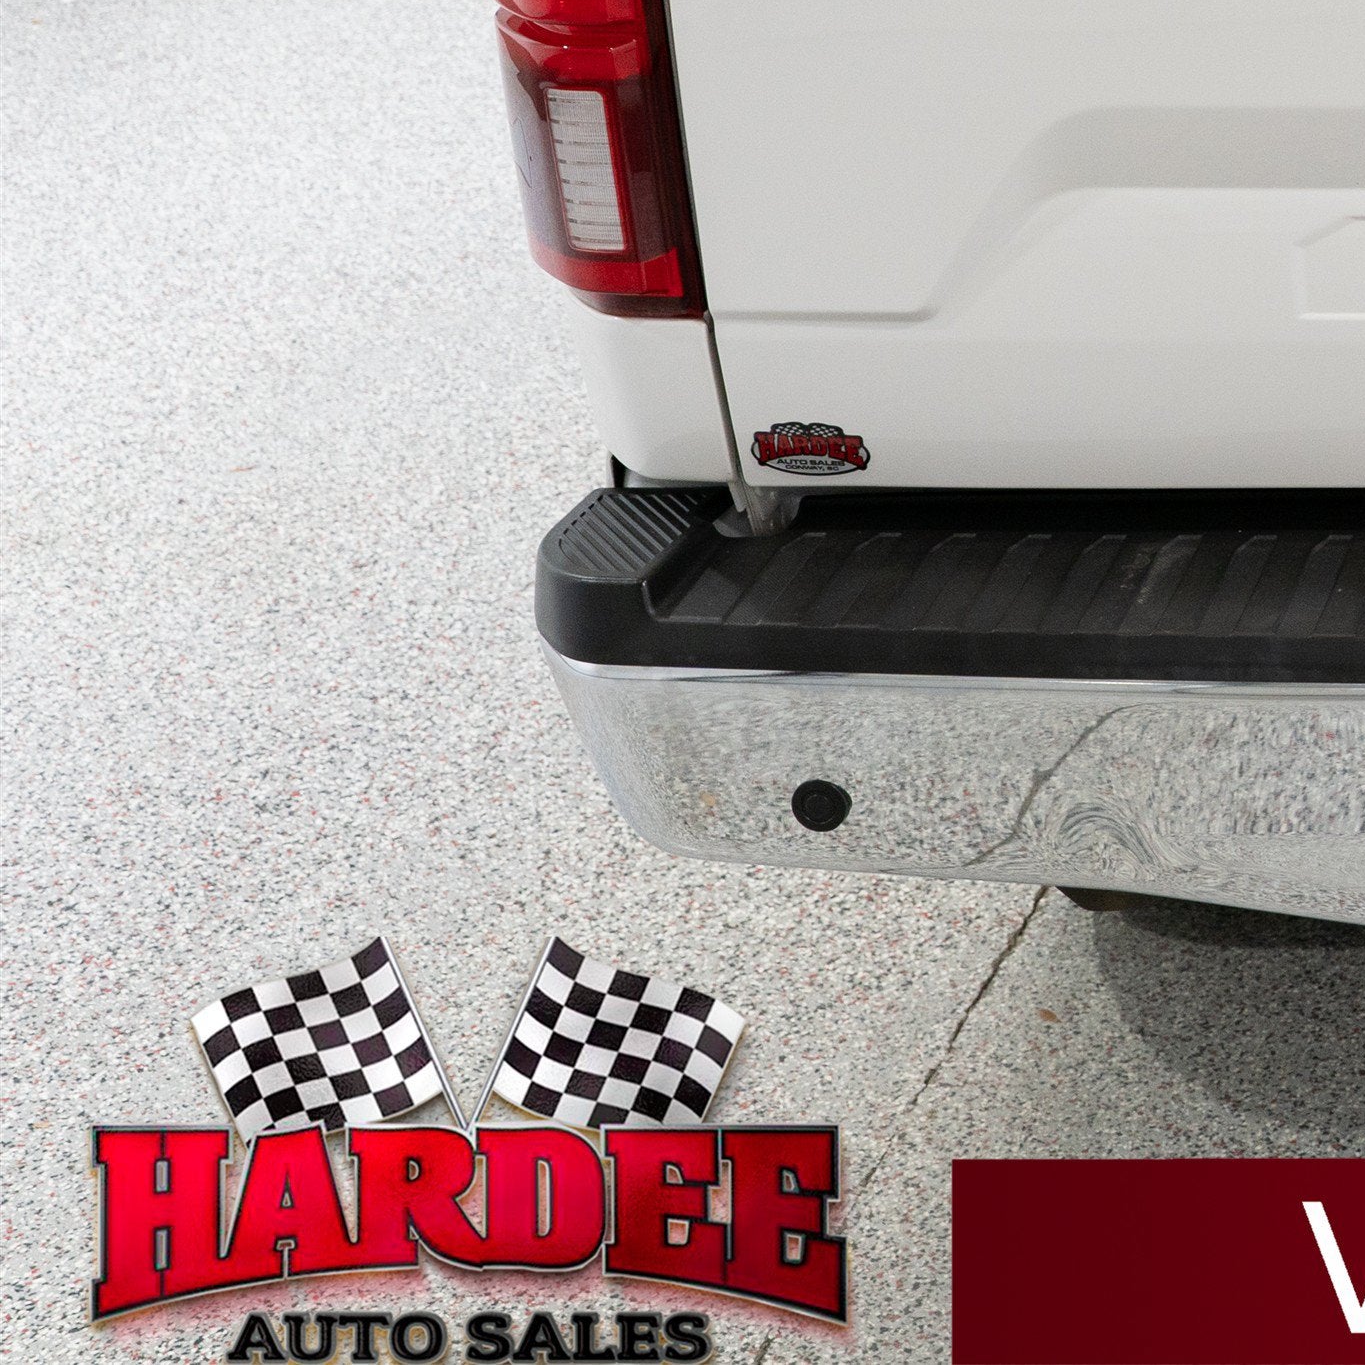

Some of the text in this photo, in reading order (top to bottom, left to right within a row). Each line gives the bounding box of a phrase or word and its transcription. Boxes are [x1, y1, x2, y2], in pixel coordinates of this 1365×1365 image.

[754, 431, 868, 469] HARDEE
[776, 458, 846, 467] AUTO SALES
